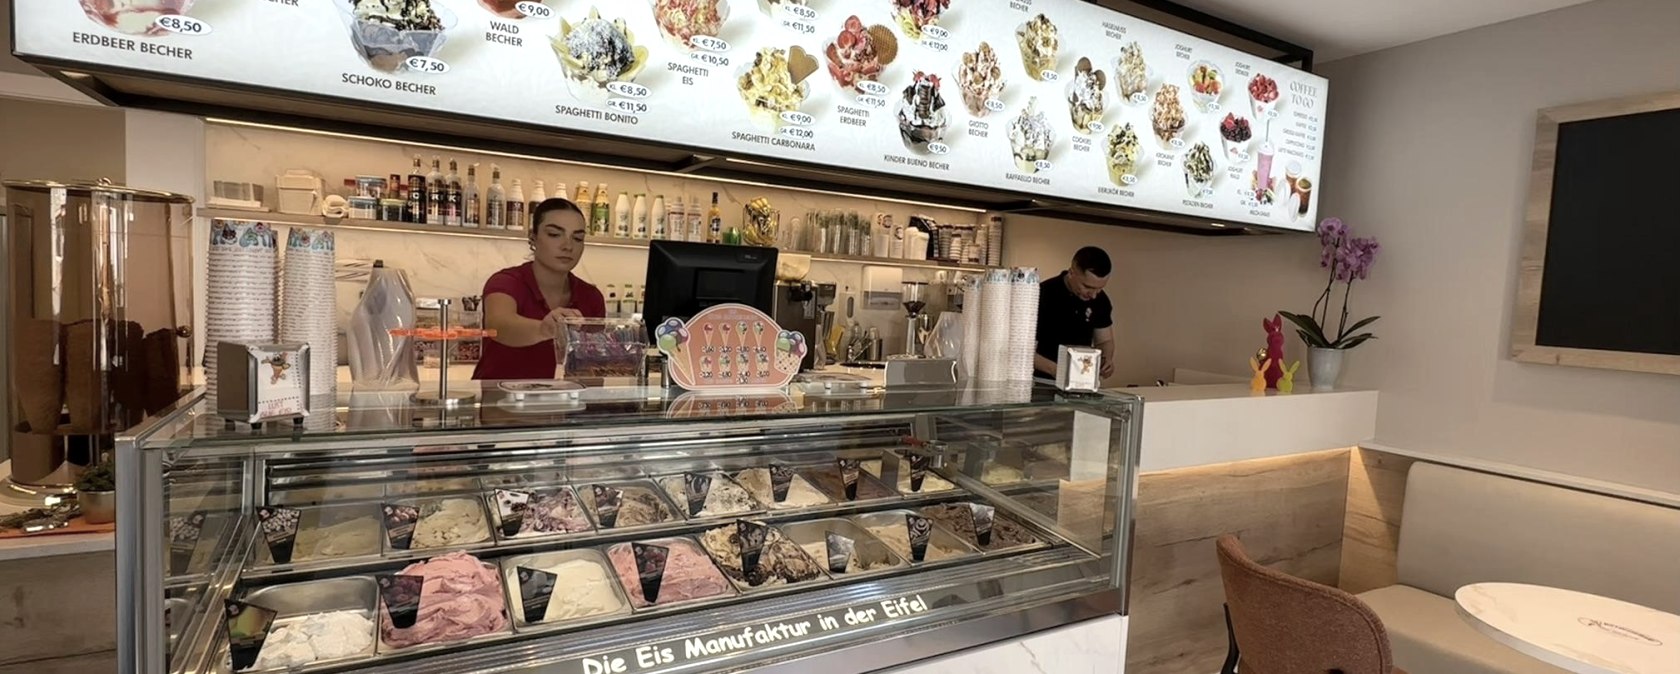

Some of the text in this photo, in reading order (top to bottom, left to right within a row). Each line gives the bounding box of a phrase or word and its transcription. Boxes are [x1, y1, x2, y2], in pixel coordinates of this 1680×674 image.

[518, 3, 550, 17] €9,00
[794, 7, 816, 18] €8,50
[159, 16, 202, 33] €8,50
[489, 21, 520, 34] WALD
[792, 22, 816, 34] €11,50
[72, 32, 193, 60] ERDBEER BECHER
[486, 32, 523, 47] BECHER
[702, 38, 726, 50] €7,50
[409, 58, 445, 72] €7,50
[701, 54, 729, 66] €10,50
[667, 62, 709, 77] SPAGHETTI
[342, 72, 436, 96] SCHOKO BECHER
[682, 77, 694, 86] EIS
[620, 84, 648, 97] €8,50
[618, 102, 648, 113] €11,50
[837, 105, 870, 118] SPAGHETTI
[555, 105, 638, 125] SPAGHETTI BONITO
[790, 114, 812, 125] €9,00
[840, 117, 866, 127] ERDBEER
[968, 120, 988, 130] GIOTTO
[790, 128, 814, 140] €12,00
[968, 128, 988, 138] BECHER
[732, 131, 816, 151] SPAGHETTI CARBONARA
[884, 154, 950, 170] KINDER BUENO BECHER
[582, 595, 928, 674] Die Eis Manufaktur in der Eifel
